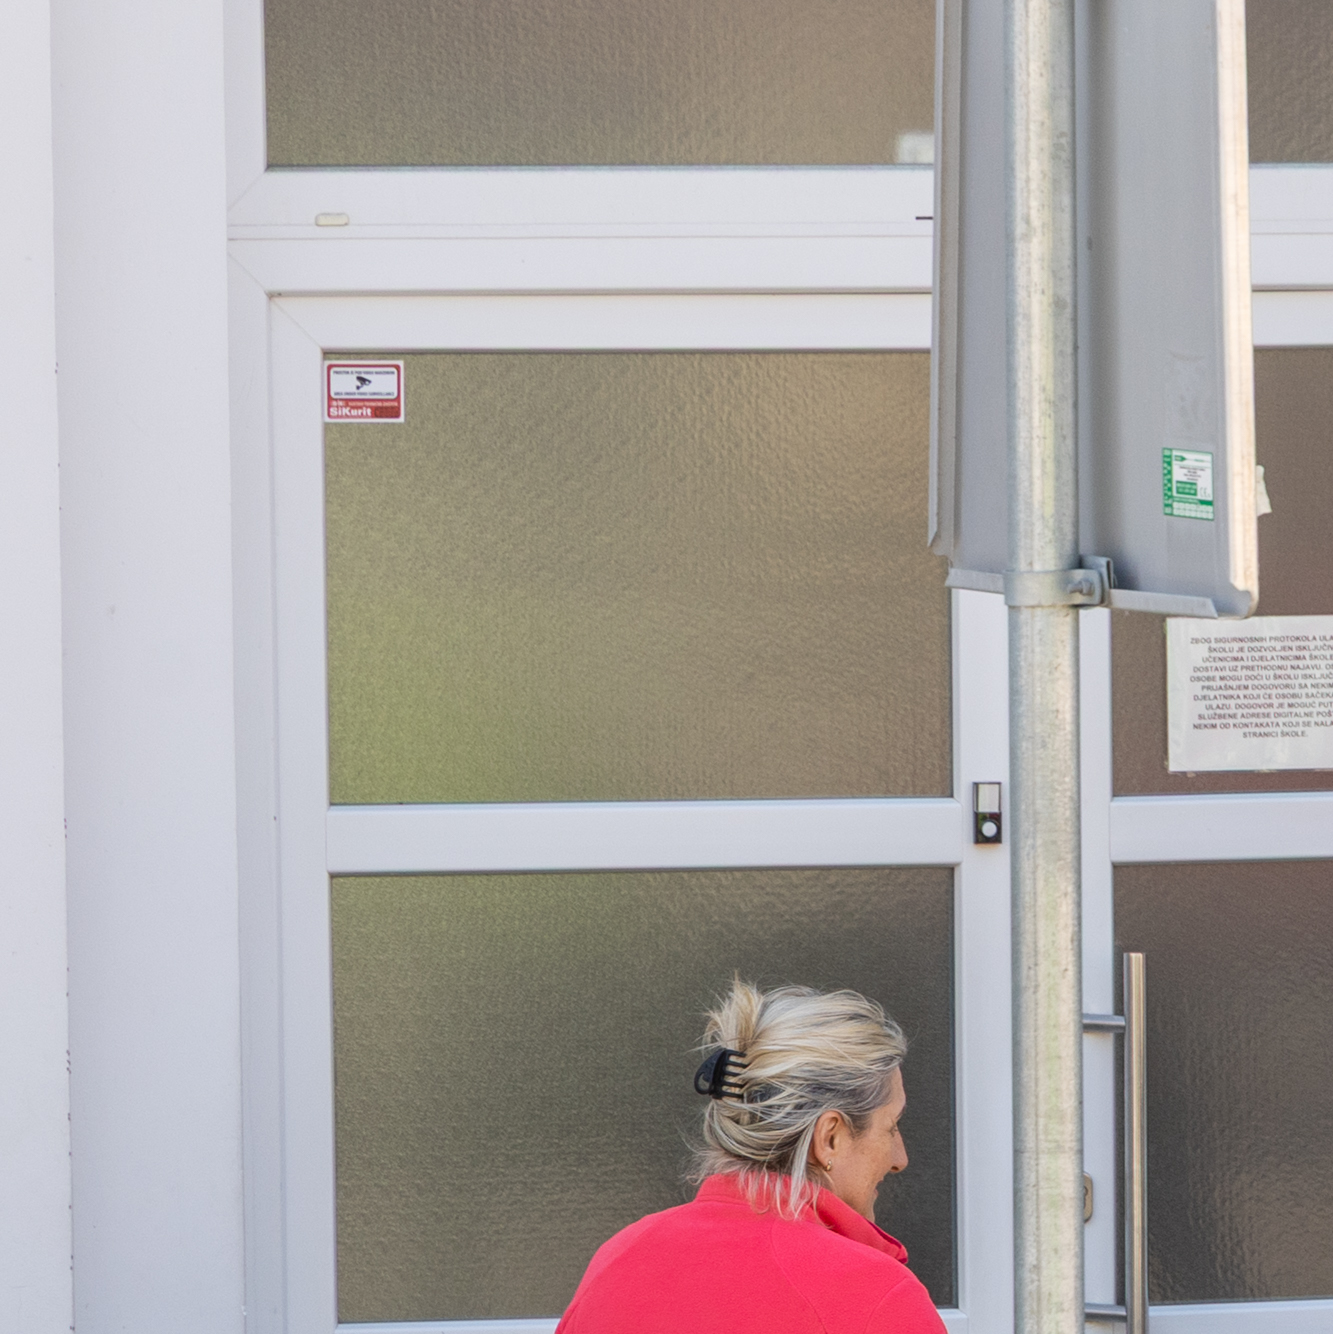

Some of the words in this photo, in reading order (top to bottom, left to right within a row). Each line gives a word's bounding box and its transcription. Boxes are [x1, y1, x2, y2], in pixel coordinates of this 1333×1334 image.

[329, 406, 372, 416] SiKurit
[1214, 636, 1267, 644] SIGURNOSNIH
[1269, 635, 1317, 643] PROTOKOLA
[1207, 645, 1234, 653] ŠKOLU
[1202, 655, 1245, 663] UČENICIMA
[1309, 653, 1333, 661] ŠKOLE
[1273, 672, 1299, 680] ŠKOLU
[1197, 711, 1238, 720] SLUŽBENE
[1273, 711, 1314, 719] DIGITALNE
